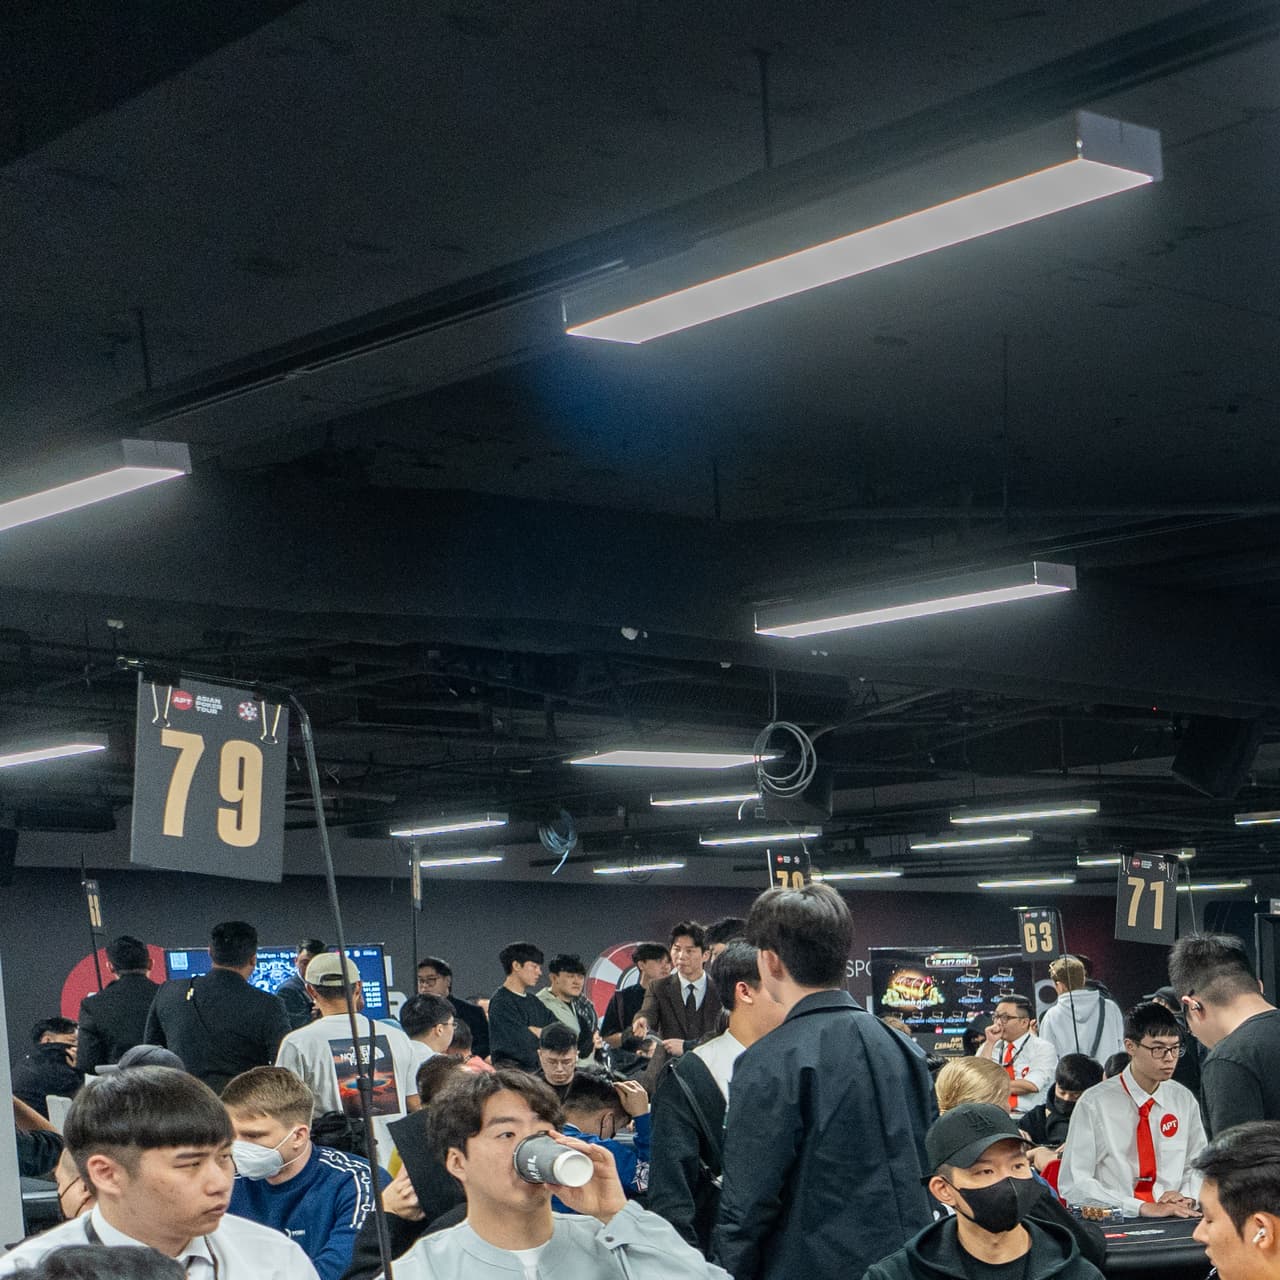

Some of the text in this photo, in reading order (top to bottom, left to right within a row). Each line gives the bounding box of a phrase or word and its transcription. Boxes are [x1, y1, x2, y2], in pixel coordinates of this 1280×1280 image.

[161, 728, 263, 847] 79
[1127, 876, 1165, 930] 71
[1024, 922, 1053, 953] 63
[1161, 1120, 1179, 1133] APT
